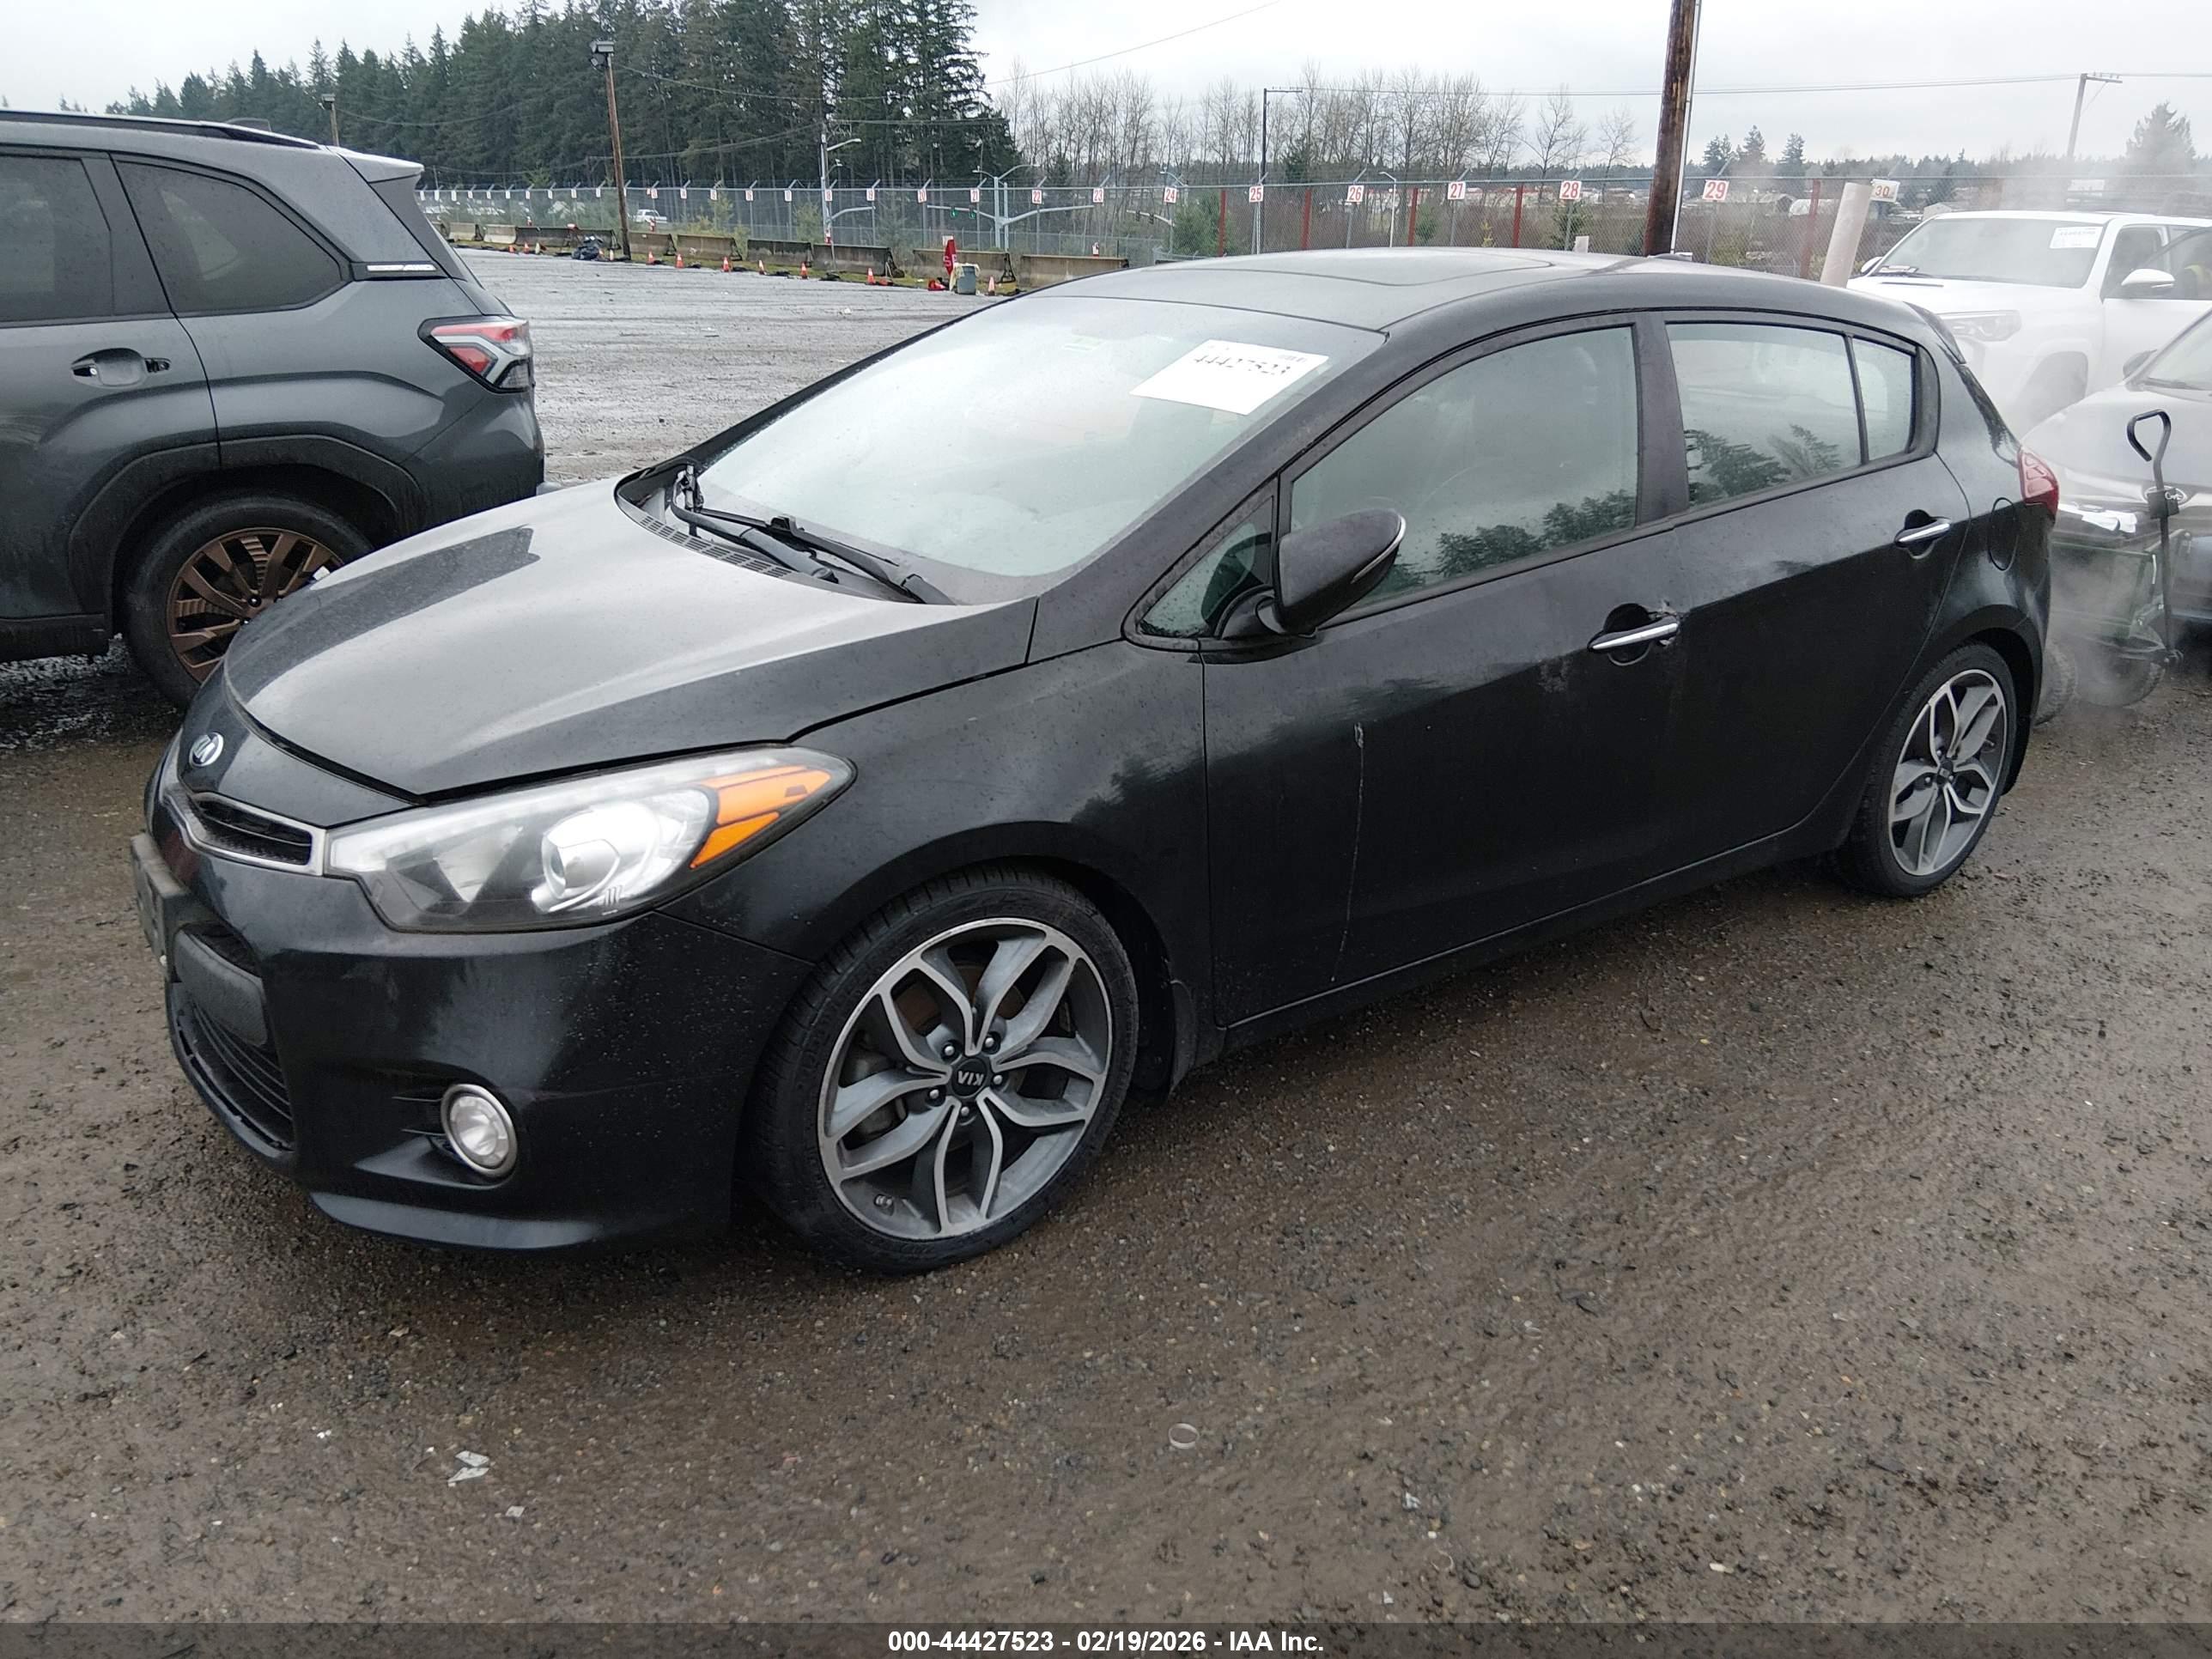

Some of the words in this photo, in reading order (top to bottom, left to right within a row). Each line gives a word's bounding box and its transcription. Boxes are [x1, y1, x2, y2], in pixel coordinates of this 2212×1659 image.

[1033, 191, 1041, 202] 22
[1094, 189, 1103, 201] 23
[1165, 188, 1176, 202] 24
[1250, 187, 1262, 201] 25
[1349, 186, 1362, 201] 26
[1450, 183, 1463, 198] 27
[1562, 181, 1579, 198] 28
[1705, 181, 1726, 198] 29
[1875, 185, 1890, 198] 30
[958, 1071, 984, 1086] KIA
